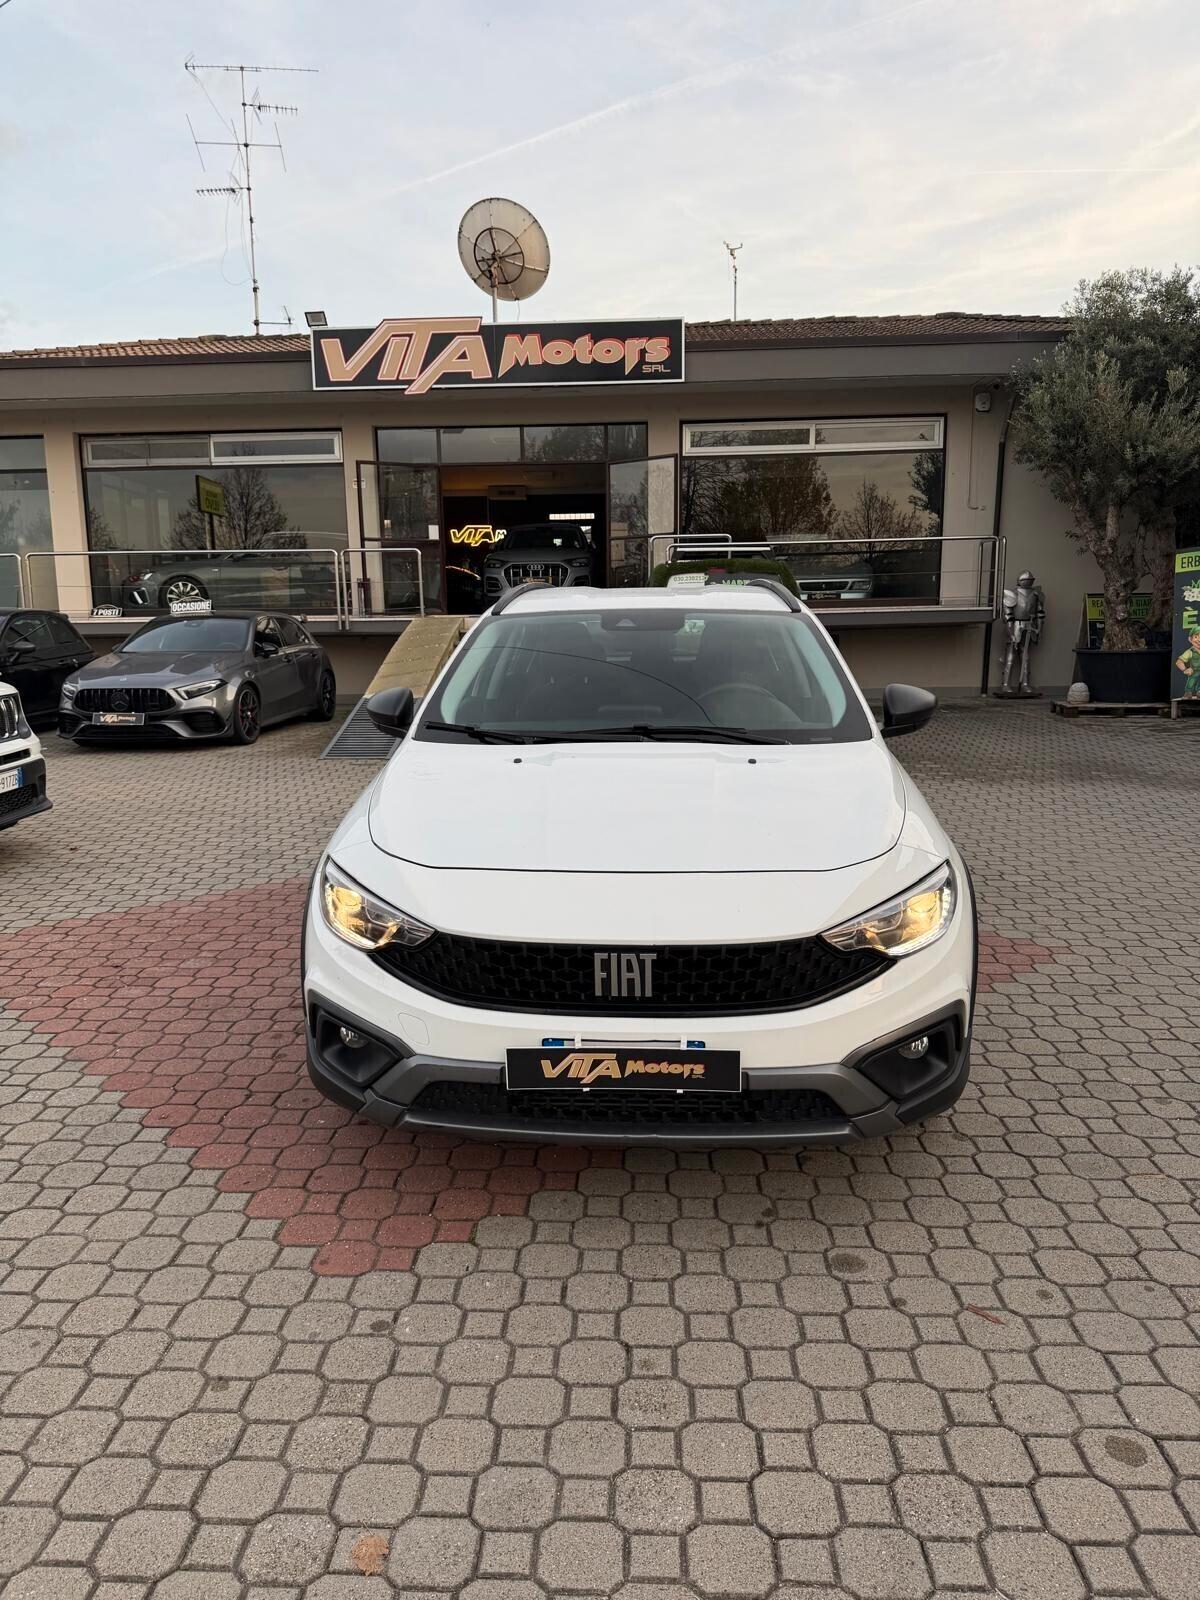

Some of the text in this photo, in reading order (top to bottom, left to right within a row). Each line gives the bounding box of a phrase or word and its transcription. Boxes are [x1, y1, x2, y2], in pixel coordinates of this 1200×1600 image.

[320, 316, 671, 395] VITA Motors
[641, 364, 671, 373] SRL
[451, 525, 496, 546] VITA
[172, 601, 211, 612] OCCASIONE
[594, 952, 657, 997] FIAT
[540, 1053, 706, 1084] VITA Motors
